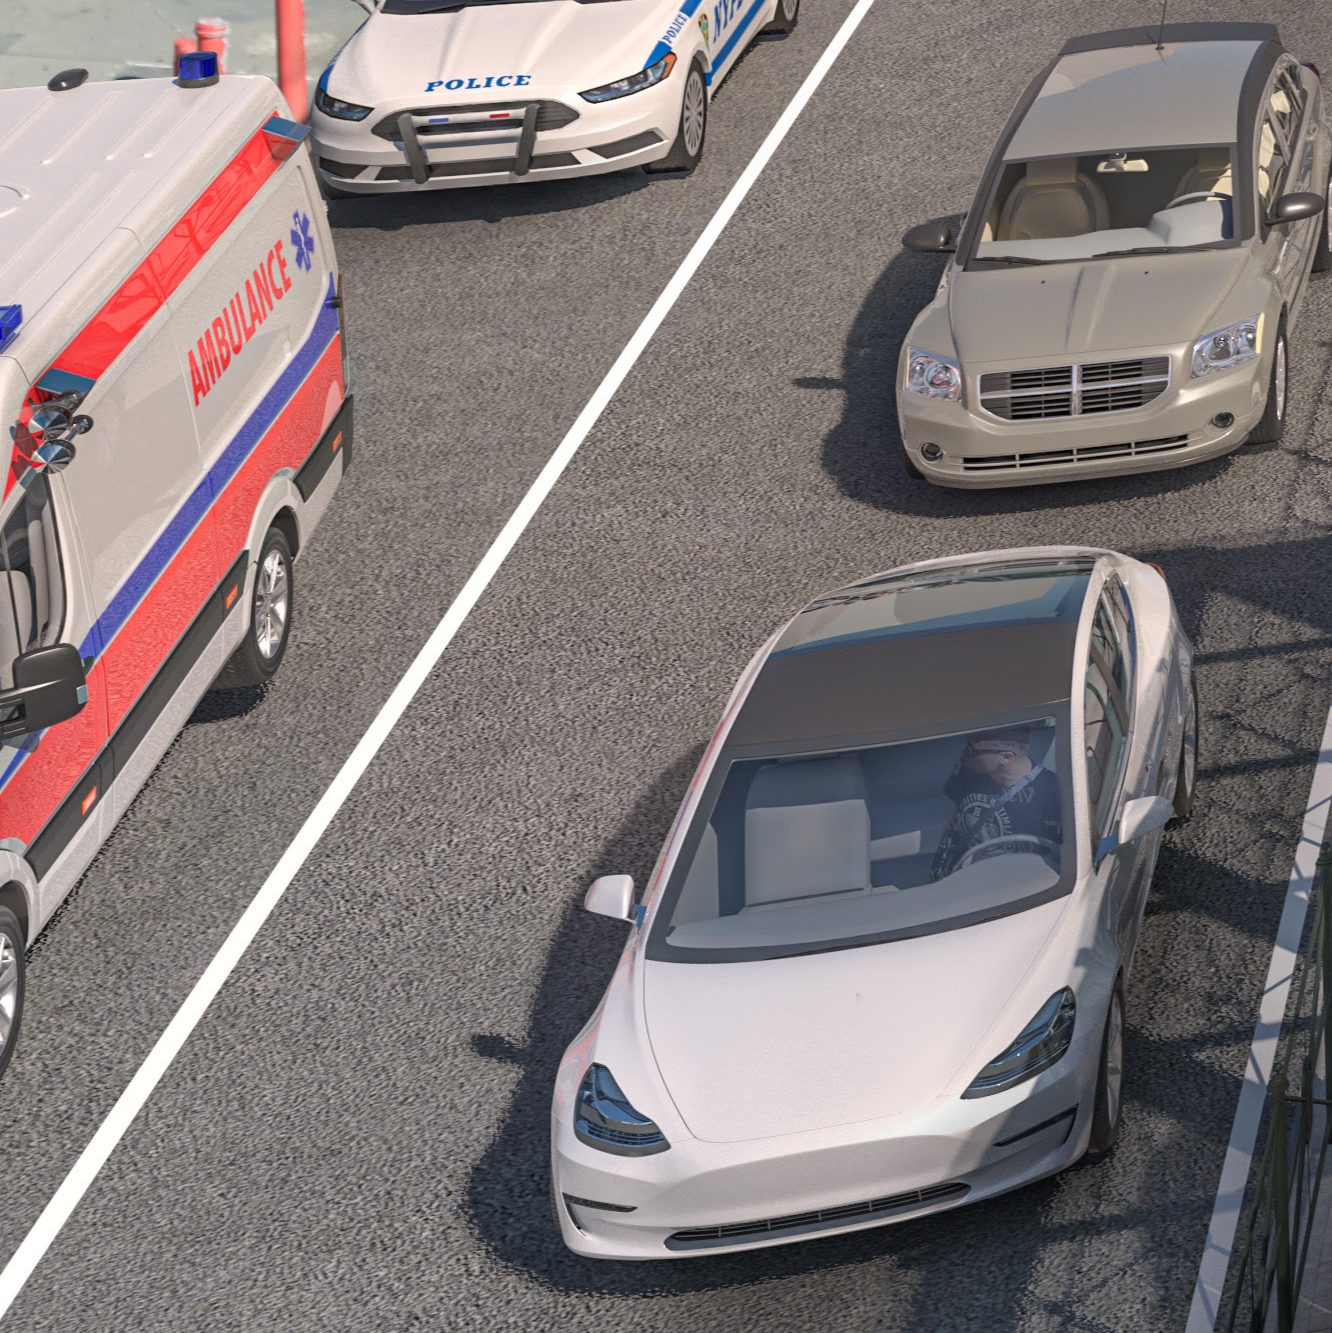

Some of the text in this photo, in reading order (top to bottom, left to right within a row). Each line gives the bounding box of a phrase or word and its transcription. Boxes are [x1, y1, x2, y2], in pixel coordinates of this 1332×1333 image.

[662, 13, 688, 44] POLICE
[424, 75, 532, 92] POLICE
[188, 239, 292, 407] AMBULANCE
